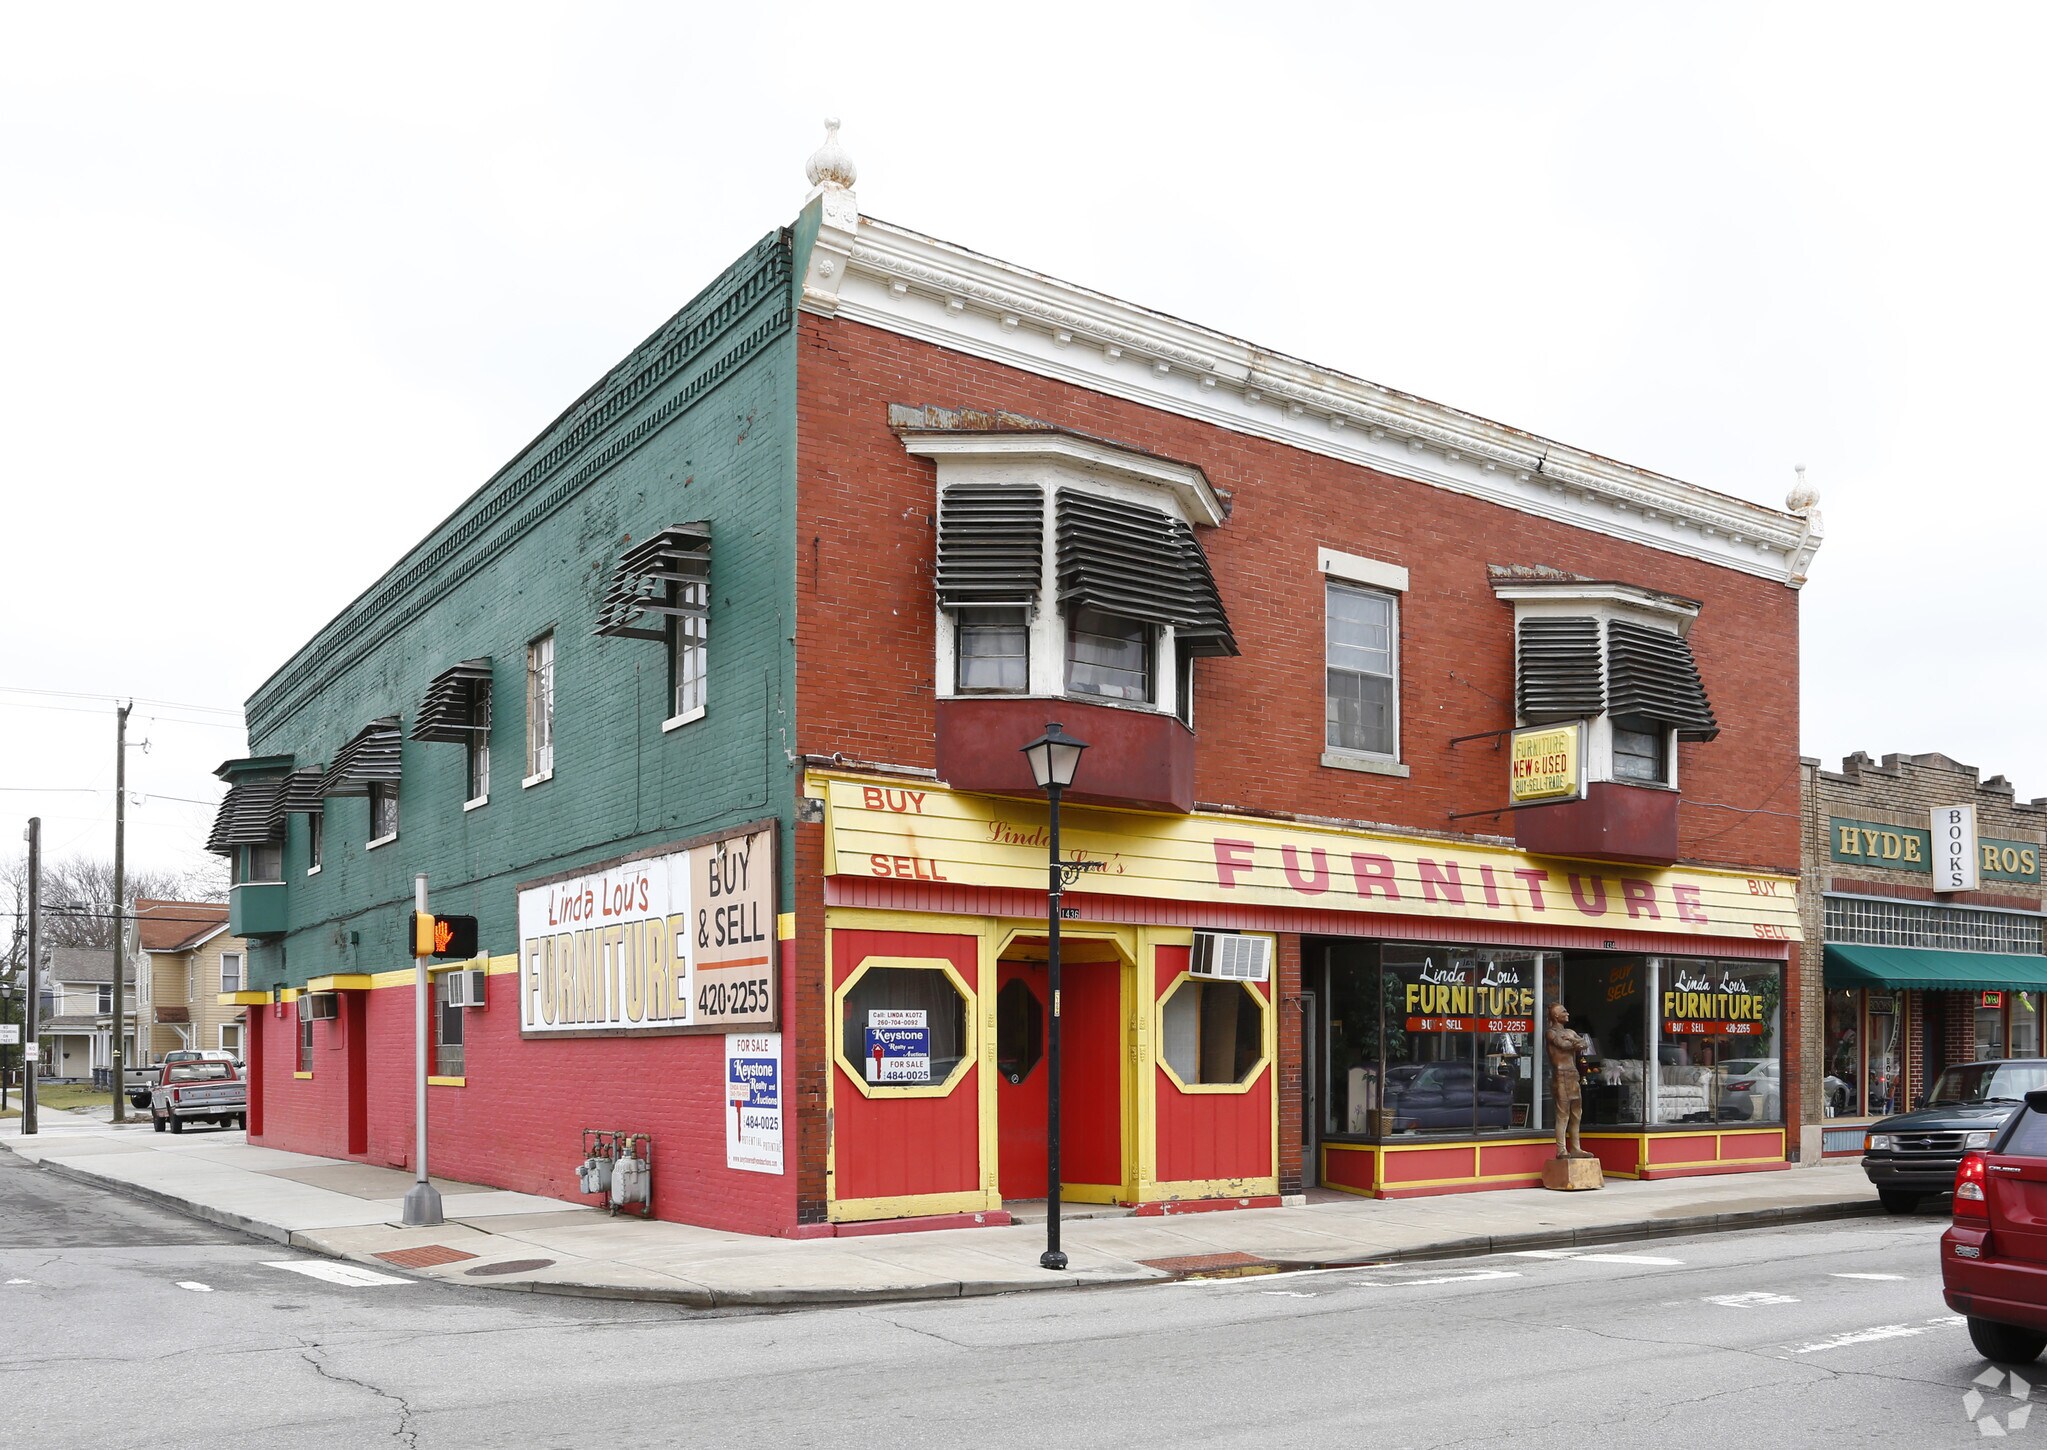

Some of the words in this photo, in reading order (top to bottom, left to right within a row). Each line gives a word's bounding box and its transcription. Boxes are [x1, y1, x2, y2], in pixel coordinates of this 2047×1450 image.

[1516, 735, 1565, 759] FURNITURE
[1514, 759, 1532, 778] NEW
[1534, 760, 1540, 774] &
[1542, 754, 1567, 774] USED
[863, 786, 926, 813] BUY
[1838, 826, 1921, 863] HYDE
[1978, 844, 2036, 876] ROS
[1949, 810, 1963, 887] BOOKS
[709, 852, 749, 898] BUY
[870, 854, 948, 880] SELL
[1213, 837, 1708, 926] FURNITURE
[1747, 880, 1776, 896] BUY
[549, 882, 594, 926] Linda
[602, 874, 648, 917] Lou's
[698, 908, 709, 949] &
[715, 902, 765, 948] SELL
[1062, 910, 1079, 919] 1436
[1752, 924, 1790, 939] SELL
[525, 912, 686, 1026] FURNITURE
[1420, 956, 1466, 984] Linda
[1481, 961, 1520, 986] Lou's
[1606, 980, 1635, 1002] SELL
[1674, 969, 1710, 992] Linda
[1719, 971, 1750, 994] Lou's
[1406, 984, 1535, 1016] FURNITURE
[1664, 992, 1763, 1020] FURNITURE
[1446, 1019, 1463, 1030] SELL
[1488, 1020, 1526, 1032] 420-2255
[1691, 1022, 1705, 1032] SELL
[737, 1039, 750, 1052] FOR
[752, 1039, 768, 1052] SALE
[872, 1029, 923, 1044] Keystone
[888, 1043, 906, 1051] Realty
[734, 1060, 772, 1082] Keystone
[886, 1071, 928, 1080] 484-0025
[750, 1078, 767, 1093] Realty
[752, 1092, 777, 1106] Auctions
[746, 1116, 778, 1130] 484-0025
